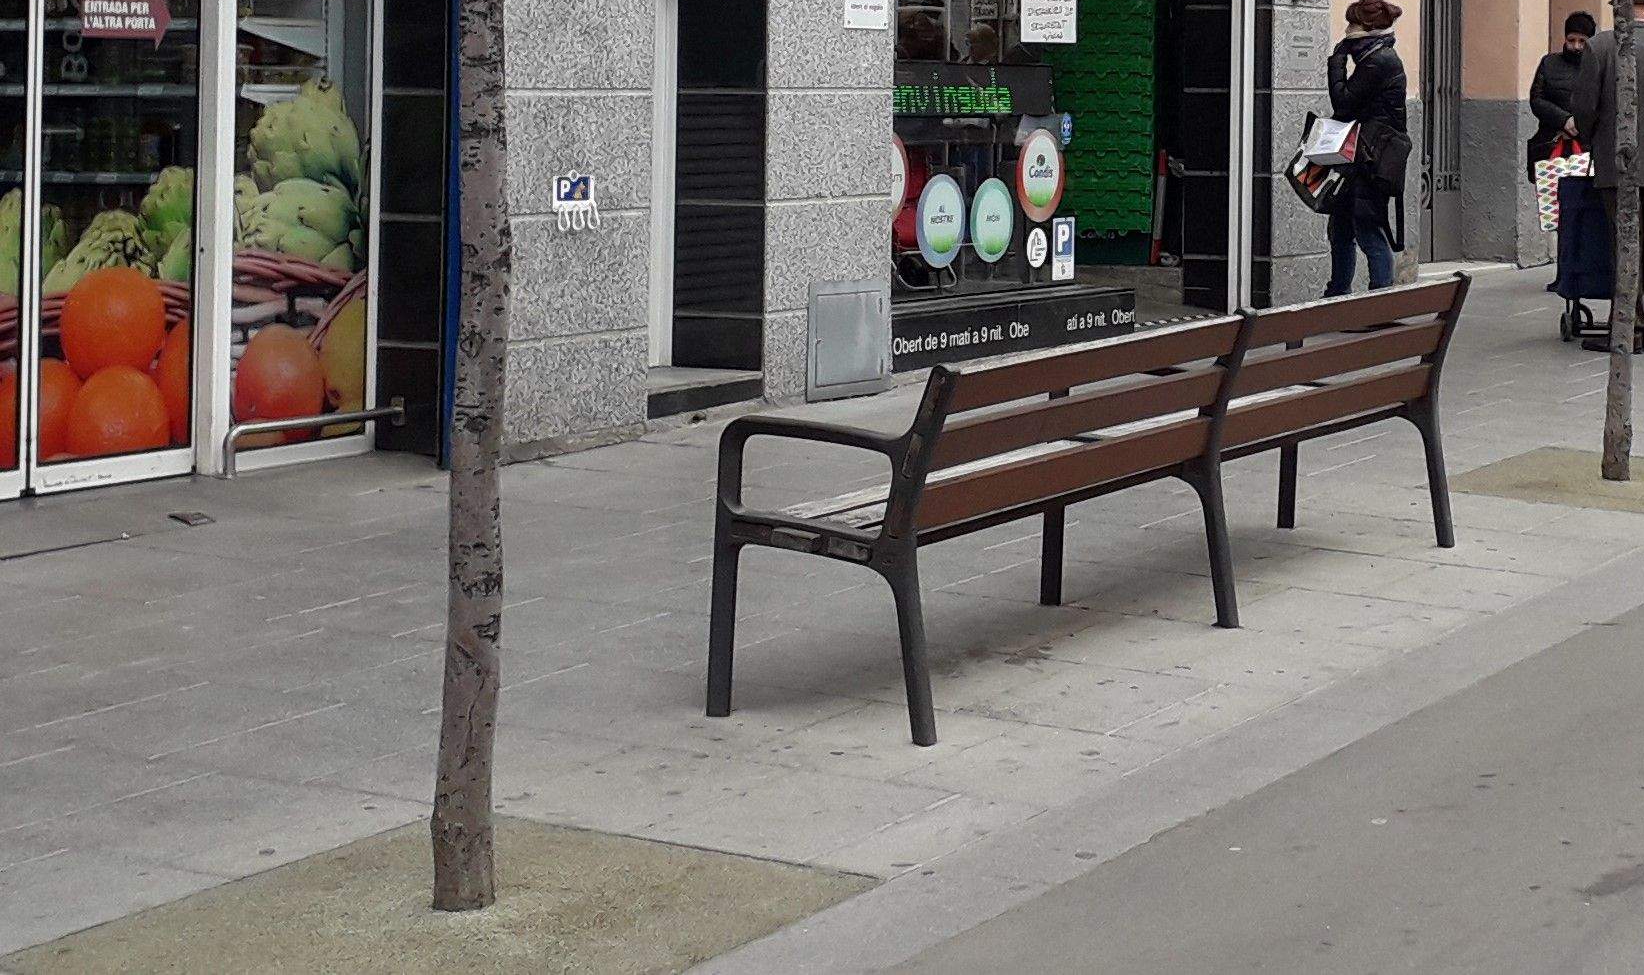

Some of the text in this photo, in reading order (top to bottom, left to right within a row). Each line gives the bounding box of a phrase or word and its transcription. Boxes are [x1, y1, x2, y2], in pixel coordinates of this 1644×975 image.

[84, 0, 149, 15] ENTRADA PER
[84, 16, 155, 30] L'ALTRA PORTA
[1057, 224, 1070, 252] P
[1079, 317, 1085, 330] a
[1087, 313, 1094, 329] 9
[893, 336, 922, 355] Obert
[924, 334, 938, 351] de
[940, 332, 948, 348] 9
[972, 331, 979, 344] a
[981, 327, 988, 342] 9
[1009, 322, 1029, 338] Obe
